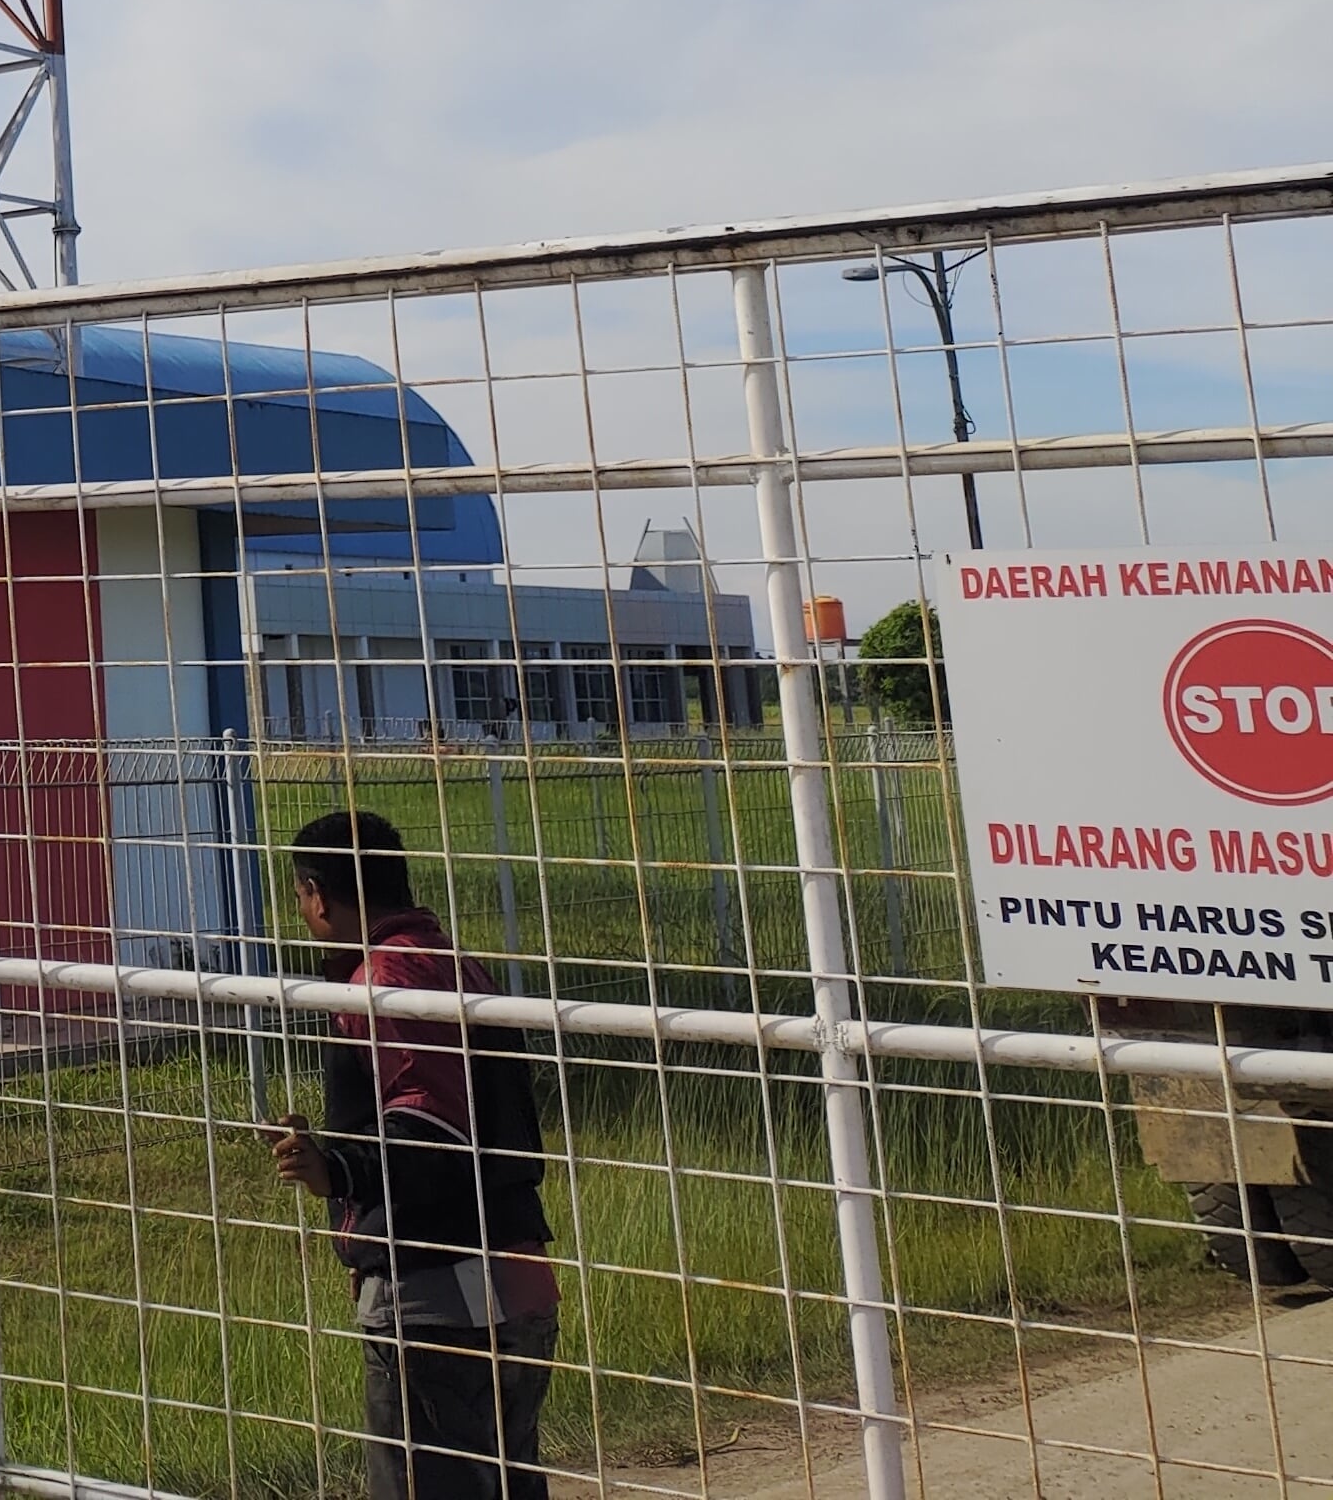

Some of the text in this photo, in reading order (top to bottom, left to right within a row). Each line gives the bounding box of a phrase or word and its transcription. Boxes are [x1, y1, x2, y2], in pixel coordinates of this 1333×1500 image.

[960, 564, 1107, 599] DAERAH
[988, 823, 1197, 873] DILARANG
[999, 897, 1333, 940] PINTU HARUS S
[1091, 941, 1297, 982] KEADAAN
